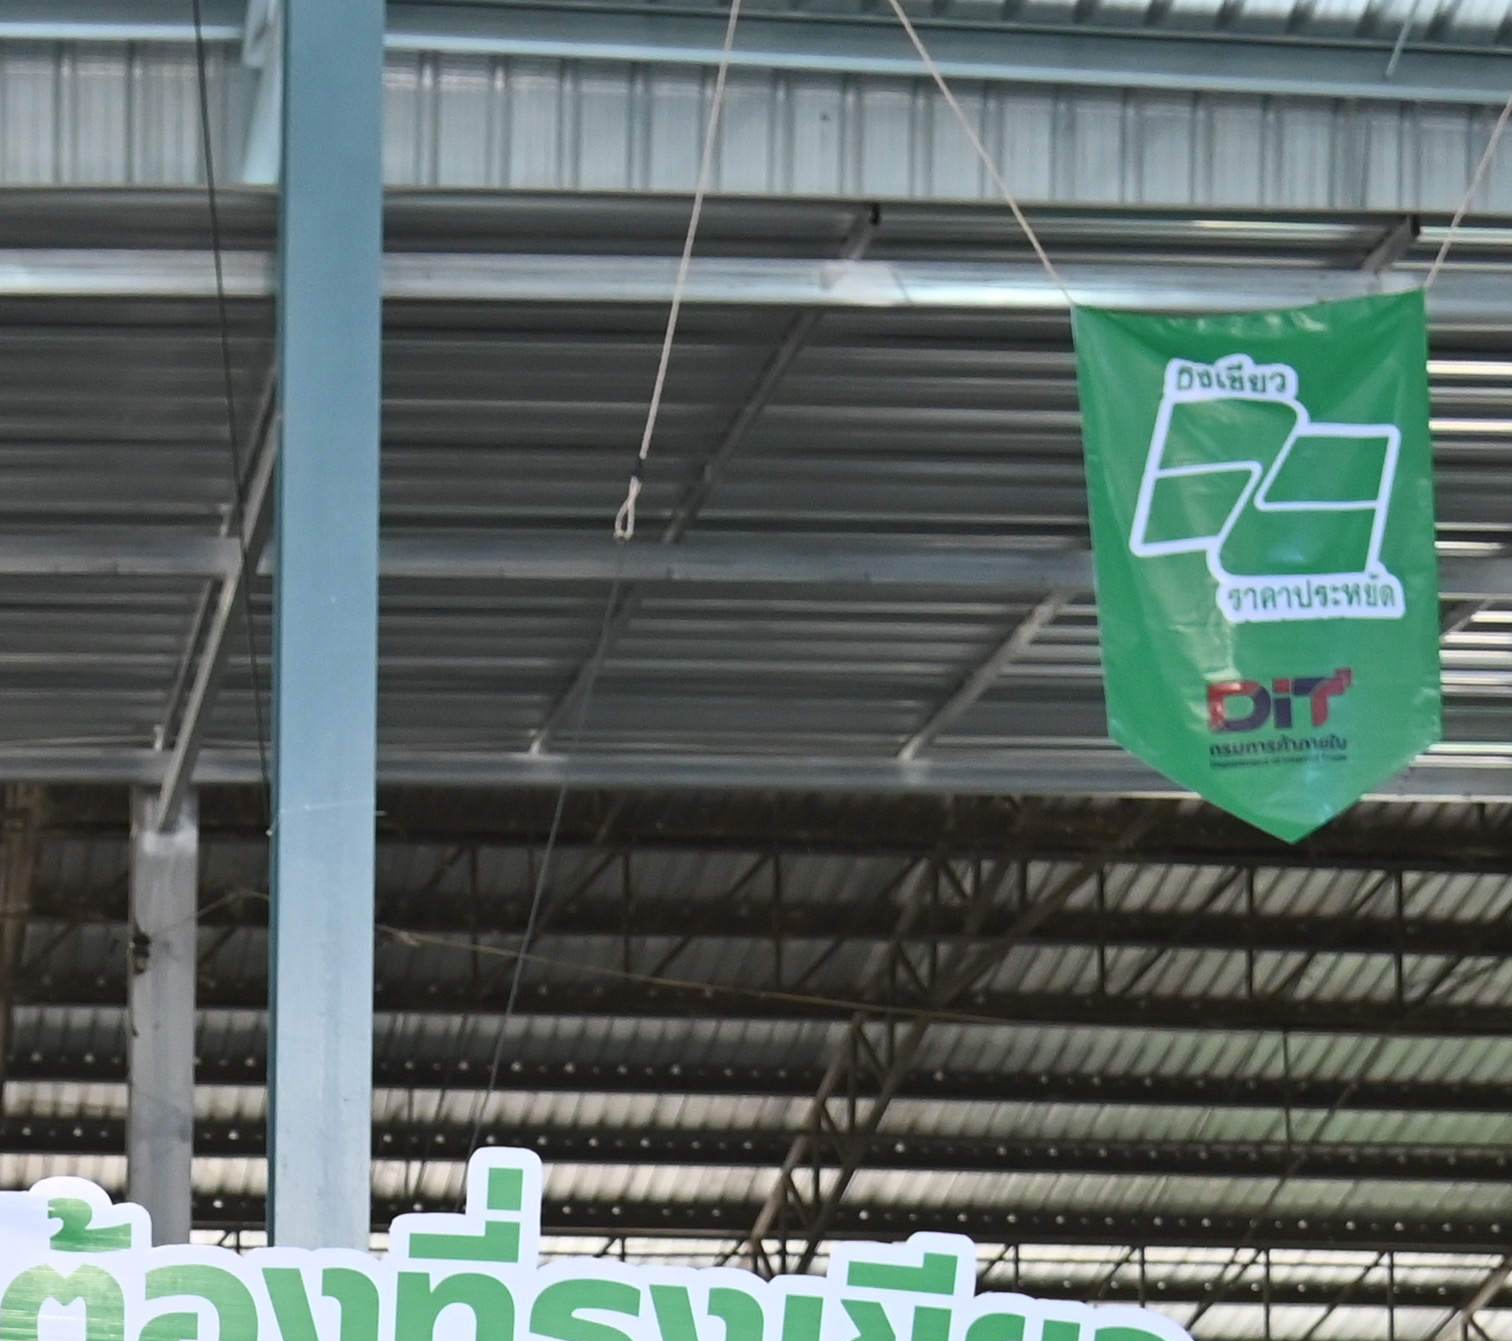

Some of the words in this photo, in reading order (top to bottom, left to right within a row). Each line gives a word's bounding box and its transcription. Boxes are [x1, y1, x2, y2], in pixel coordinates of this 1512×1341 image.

[1176, 364, 1287, 392] ธงเขียว
[1227, 574, 1397, 611] ราคาประหยัด
